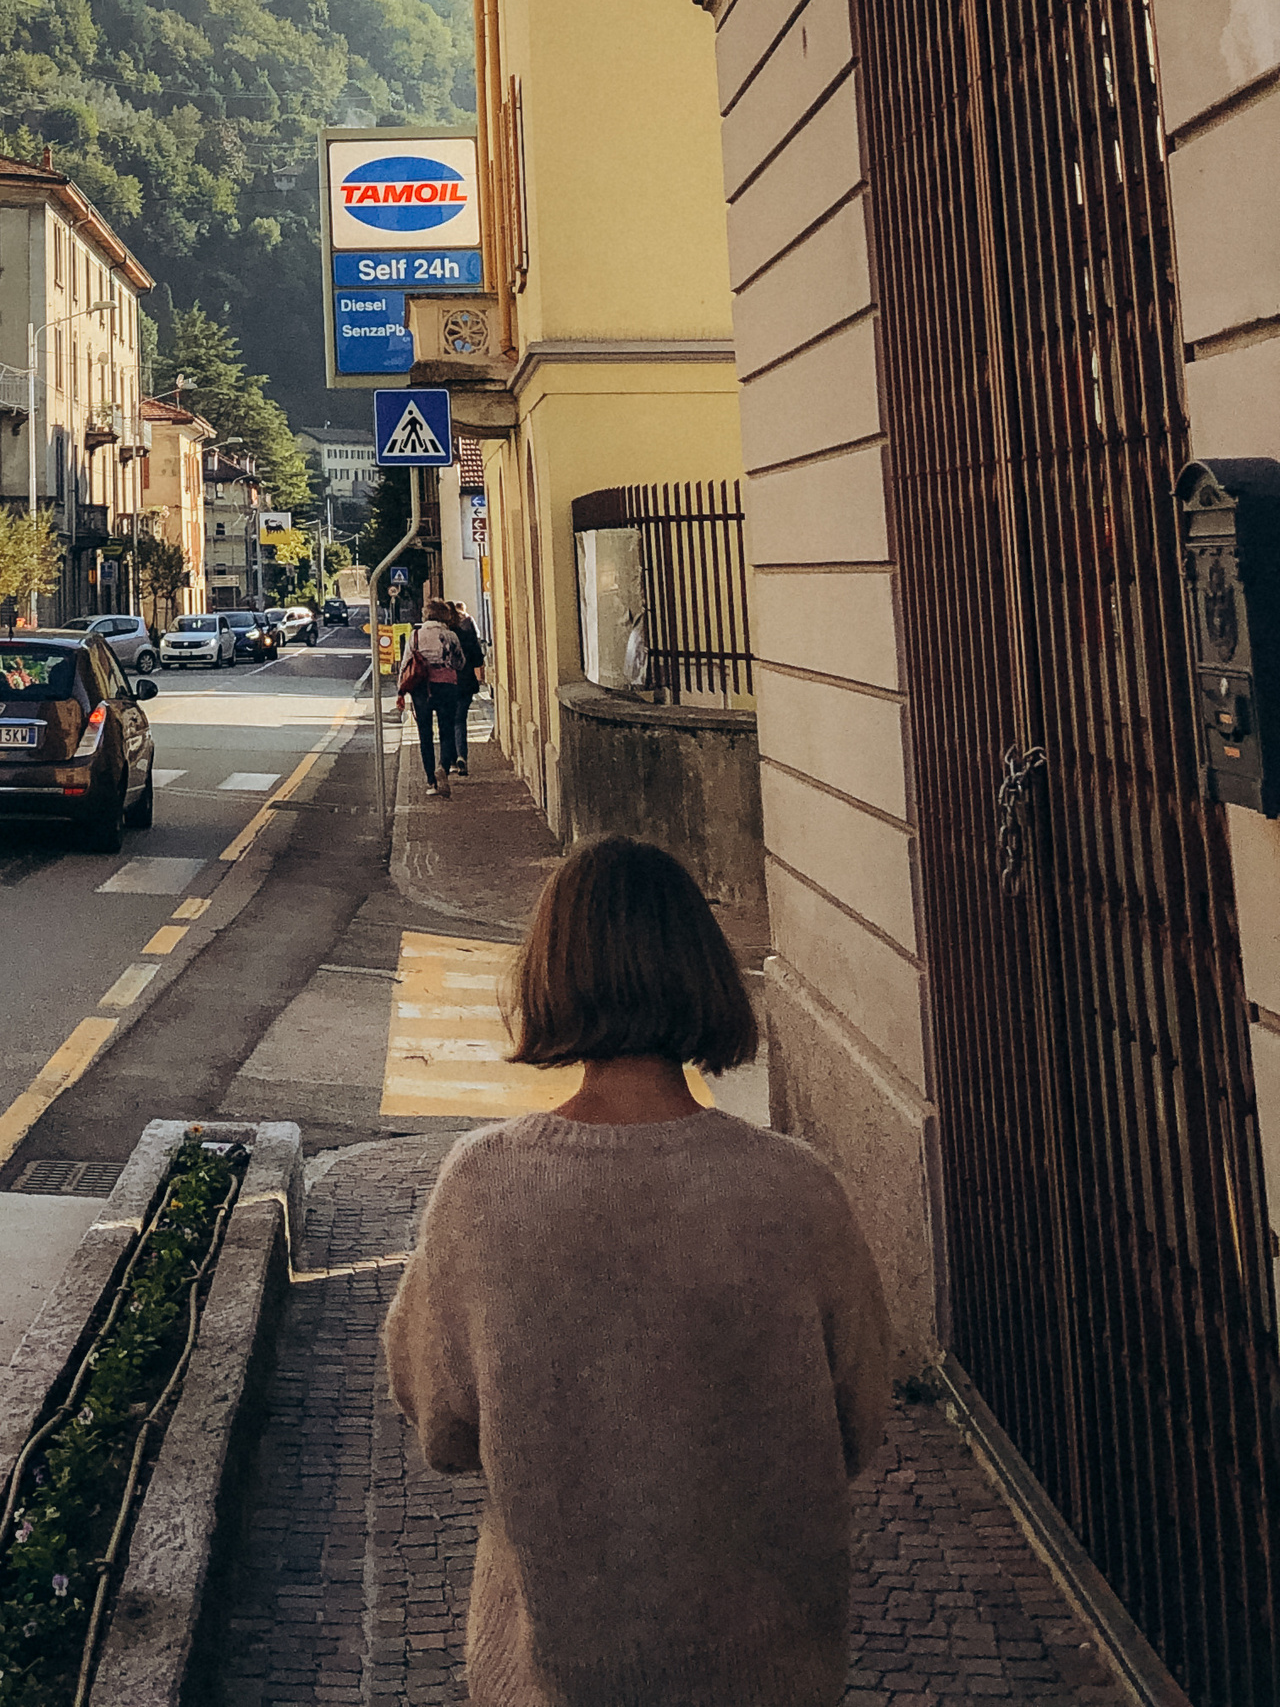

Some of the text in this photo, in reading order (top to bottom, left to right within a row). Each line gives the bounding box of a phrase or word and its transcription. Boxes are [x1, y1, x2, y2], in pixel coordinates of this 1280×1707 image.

[340, 183, 468, 204] TAMOIL
[358, 257, 460, 281] Self 24h
[340, 298, 386, 312] Diesel
[342, 323, 405, 338] SenzaPb
